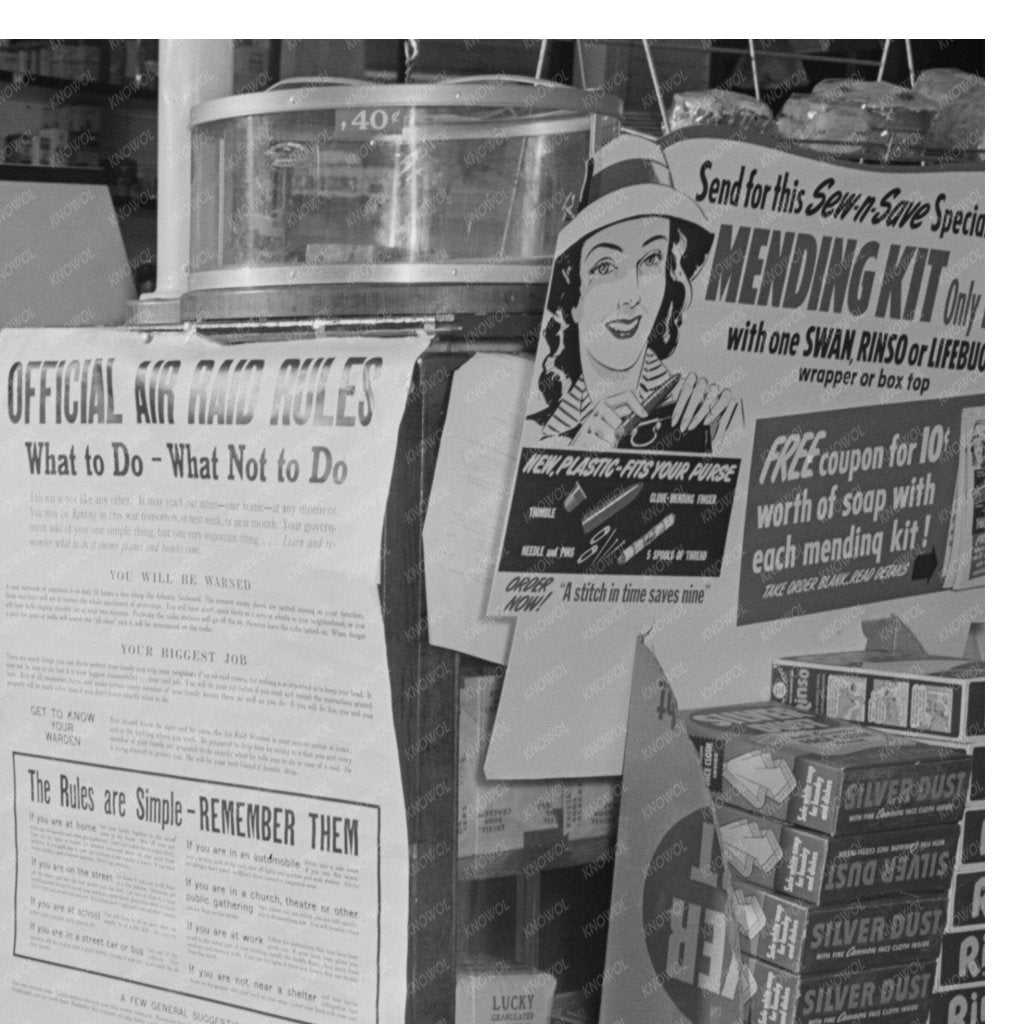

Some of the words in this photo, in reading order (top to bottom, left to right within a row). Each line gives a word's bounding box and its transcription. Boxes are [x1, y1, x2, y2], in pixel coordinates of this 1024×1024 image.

[696, 160, 745, 207] Send
[743, 169, 770, 210] for
[773, 172, 805, 216] this
[805, 178, 930, 230] Sew-n-Save
[705, 224, 880, 317] MENDING
[875, 244, 950, 323] KIT
[943, 278, 981, 337] Only
[727, 321, 767, 352] with
[769, 330, 800, 357] one
[803, 326, 856, 366] SWAN,
[856, 331, 908, 365] RINSO
[908, 342, 928, 367] or
[8, 357, 123, 425] OFFICIAL
[134, 359, 182, 425] AIR
[187, 359, 265, 425] RAID
[269, 356, 383, 427] RULES
[799, 367, 857, 389] wrapper
[860, 371, 875, 387] or
[877, 369, 903, 390] box
[907, 373, 930, 396] top
[25, 441, 77, 476] What
[84, 444, 105, 476] to
[111, 442, 144, 477] Do
[166, 442, 219, 481] What
[227, 443, 267, 483] Not
[277, 447, 300, 483] to
[309, 445, 348, 485] Do
[759, 430, 827, 486] FREE
[819, 446, 885, 483] coupon
[888, 433, 917, 468] for
[651, 459, 688, 481] YOUR
[688, 463, 738, 483] PURSE
[529, 506, 556, 519] THIMBLE
[757, 488, 812, 530] worth
[816, 484, 838, 521] of
[842, 488, 887, 523] soap
[892, 472, 936, 510] with
[521, 545, 545, 558] NEEDLE
[646, 549, 652, 561] 5
[676, 549, 684, 561] OF
[685, 550, 708, 561] THREAD
[752, 534, 797, 575] each
[802, 524, 884, 565] mending
[110, 570, 133, 582] YOU
[141, 572, 174, 584] WILL
[181, 574, 197, 587] BE
[204, 575, 251, 591] WARNED
[505, 576, 555, 593] ORDER
[762, 583, 787, 600] TAKE
[786, 576, 819, 596] ORDER
[874, 561, 910, 581] DETAILS
[504, 591, 553, 613] NOW!
[574, 582, 608, 603] stitch
[608, 582, 621, 603] in
[622, 583, 646, 603] time
[647, 589, 680, 605] saves
[121, 643, 153, 657] YOUR
[161, 648, 216, 663] BIGGEST
[224, 652, 248, 667] JOB
[30, 705, 47, 717] GET
[51, 708, 63, 720] TO
[67, 711, 96, 724] KNOW
[44, 731, 82, 747] WARDEN
[50, 722, 74, 734] YOUR
[28, 769, 51, 805] The
[60, 774, 95, 812] Rules
[104, 788, 126, 818] are
[136, 786, 183, 831] Simple
[199, 796, 296, 847] REMEMBER
[308, 812, 360, 857] THEM
[253, 853, 301, 869] automobile
[185, 877, 192, 888] If
[194, 881, 209, 893] you
[212, 884, 226, 896] are
[229, 885, 238, 897] in
[250, 889, 283, 907] church,
[285, 896, 317, 912] theatre
[321, 903, 331, 914] or
[334, 906, 359, 920] other
[213, 897, 254, 915] gathering
[810, 915, 885, 950] SILVER
[888, 909, 944, 941] DUST
[120, 993, 126, 1002] A
[129, 996, 147, 1008] FEW
[151, 1001, 188, 1020] GENERAL
[492, 995, 534, 1011] LUCKY
